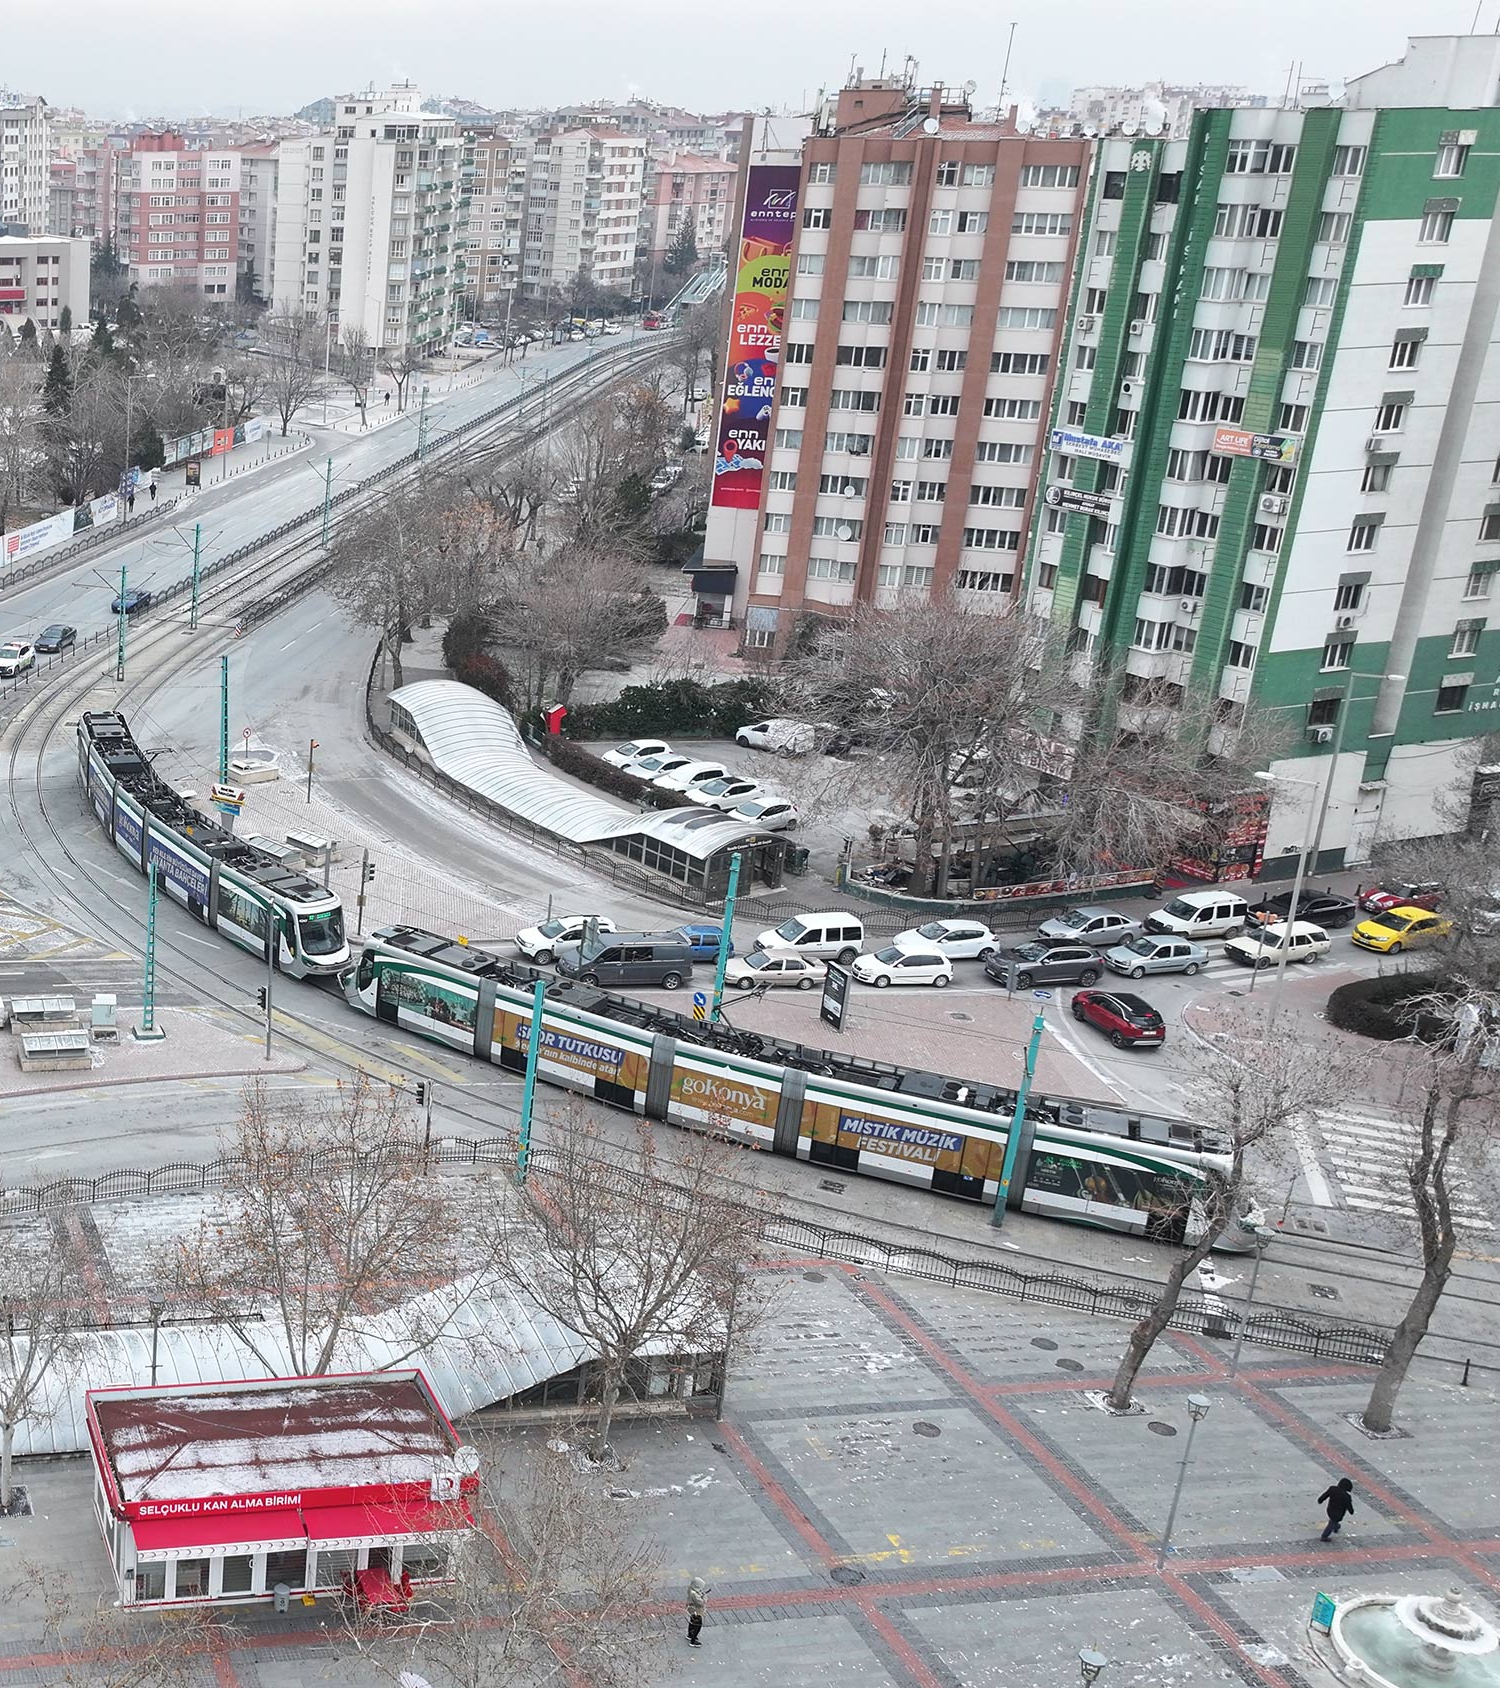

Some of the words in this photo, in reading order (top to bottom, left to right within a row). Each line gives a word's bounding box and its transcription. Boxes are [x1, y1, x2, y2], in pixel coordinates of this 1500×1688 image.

[737, 323, 768, 334] enn
[728, 429, 759, 439] enn
[1064, 433, 1098, 446] Mustafa
[1220, 434, 1234, 442] ART
[1468, 701, 1500, 712] İŞHA
[517, 1025, 556, 1046] SOR
[557, 1035, 623, 1064] TUTKUSU
[558, 1050, 598, 1070] kalbinde
[843, 1118, 901, 1140] MİSTİK
[901, 1129, 959, 1150] MÜZİK
[856, 1136, 942, 1162] FESTİVALİ
[139, 1503, 200, 1516] SELÇUKLU
[203, 1500, 228, 1511] KAN
[230, 1498, 264, 1509] ALMA
[265, 1494, 301, 1507] BİRİMİ
